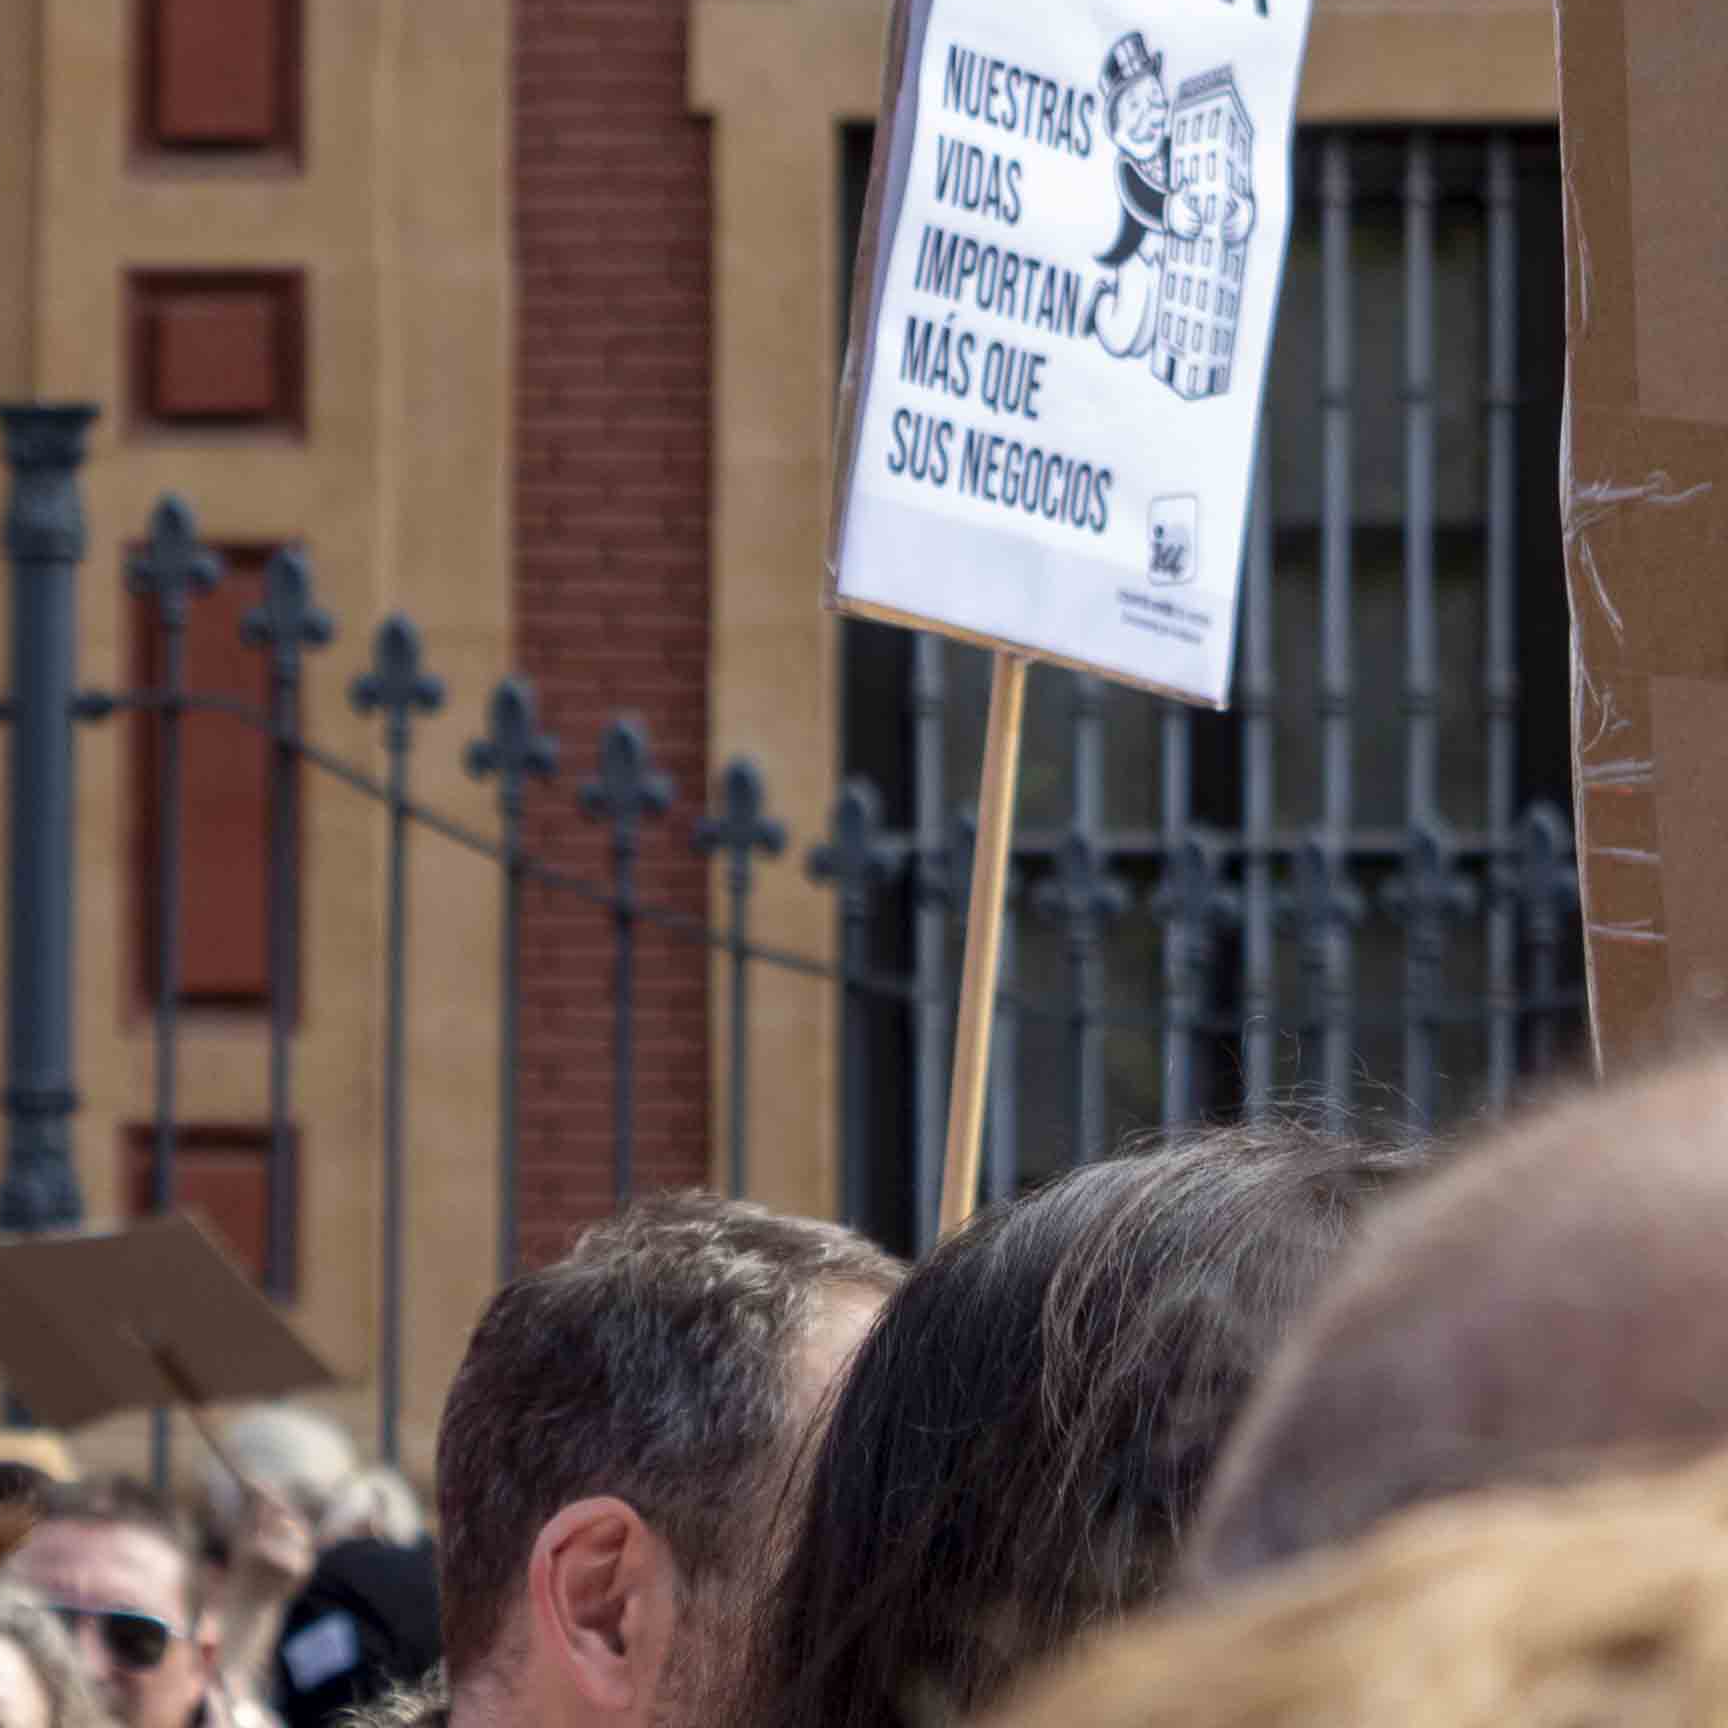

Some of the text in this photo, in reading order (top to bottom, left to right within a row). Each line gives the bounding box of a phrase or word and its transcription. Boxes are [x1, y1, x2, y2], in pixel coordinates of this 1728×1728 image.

[942, 44, 1095, 158] NUESTRAS
[935, 134, 1023, 226] VIDAS
[913, 224, 1082, 339] IMPORTAN
[898, 311, 1047, 421] MÁS QUE
[887, 407, 1113, 534] SUS NEGOCIOS
